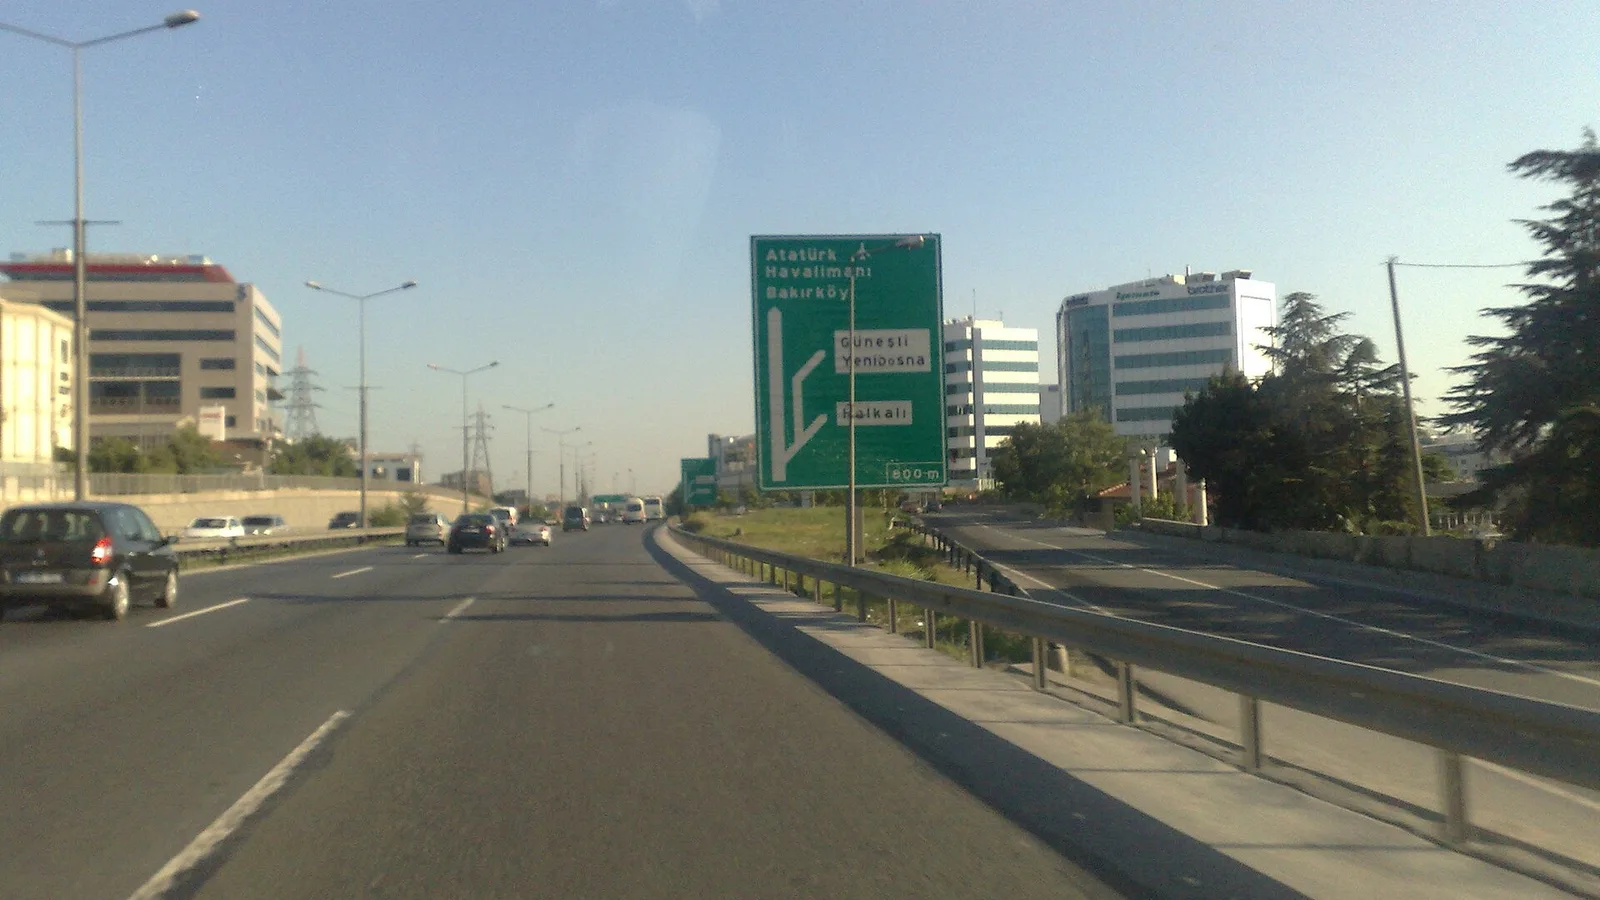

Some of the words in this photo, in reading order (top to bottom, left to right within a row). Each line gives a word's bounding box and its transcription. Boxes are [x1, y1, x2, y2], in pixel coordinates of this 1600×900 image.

[766, 248, 836, 262] Atatürk
[766, 265, 872, 278] Havalimanı
[766, 284, 849, 301] Bakırköy
[841, 334, 908, 348] Güneşli
[842, 354, 925, 366] Yenibosna
[892, 468, 922, 479] 800
[928, 470, 939, 479] m
